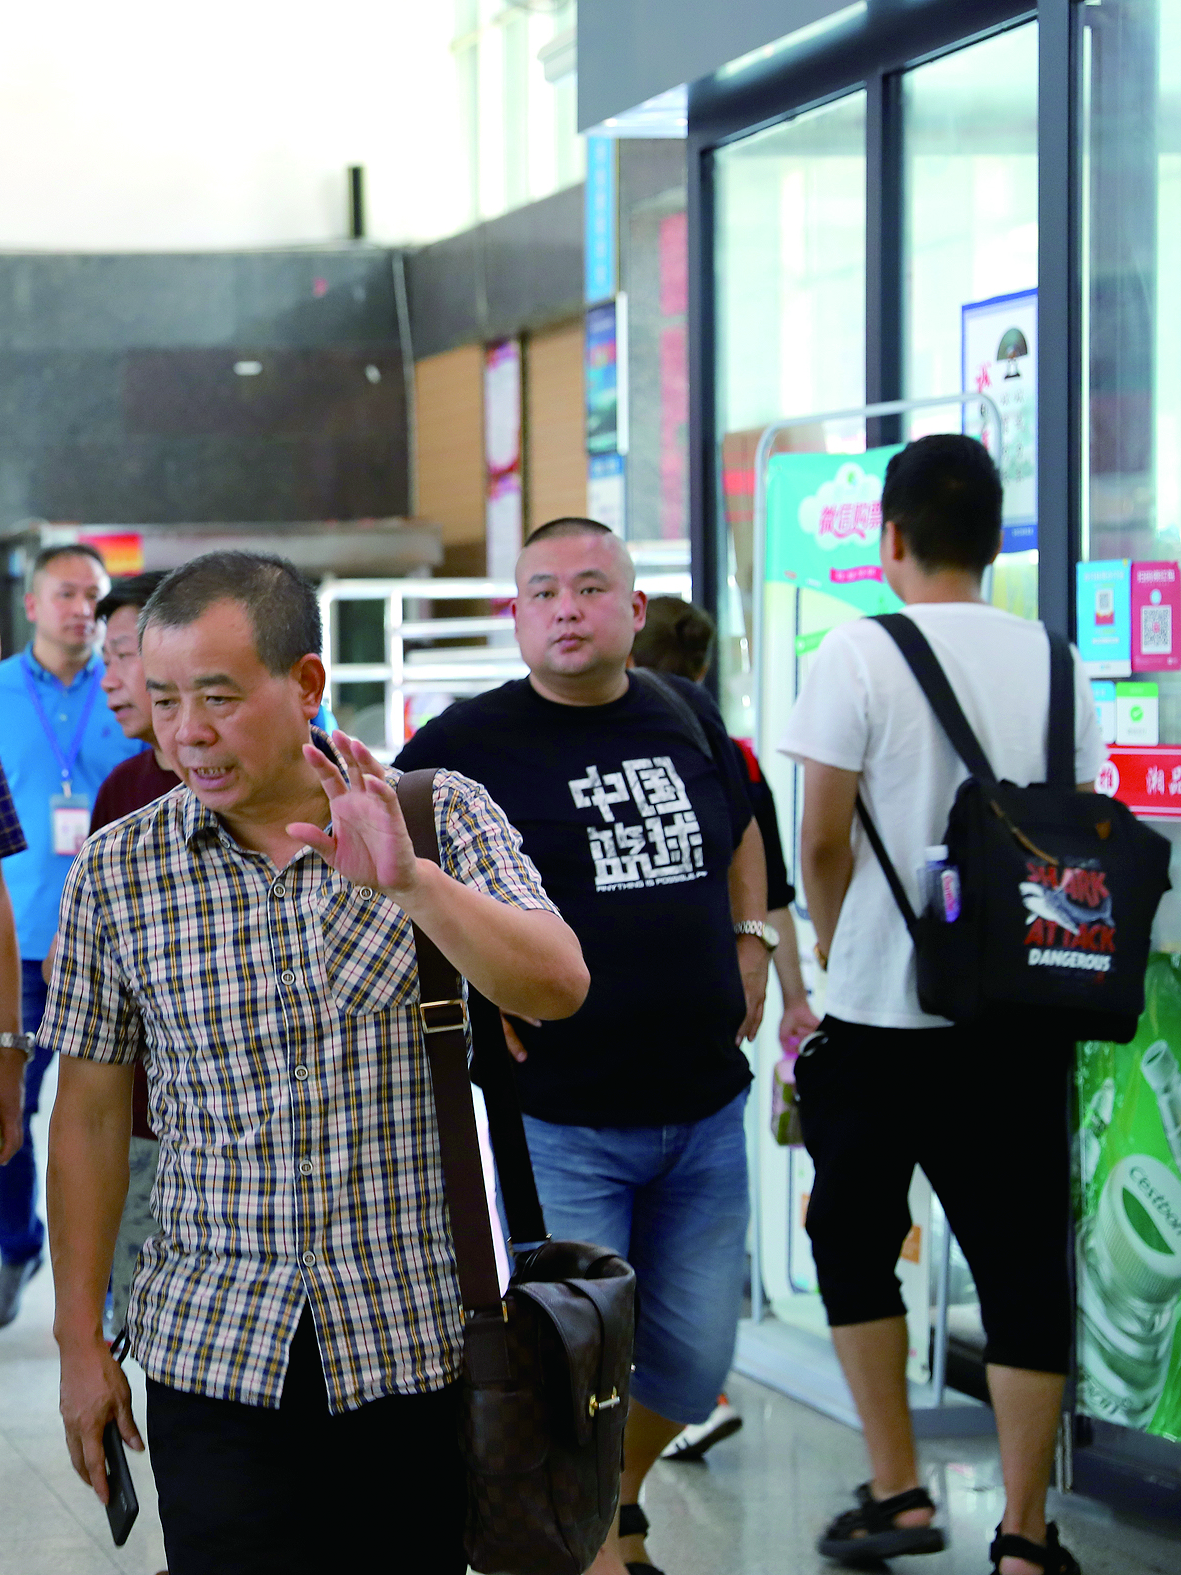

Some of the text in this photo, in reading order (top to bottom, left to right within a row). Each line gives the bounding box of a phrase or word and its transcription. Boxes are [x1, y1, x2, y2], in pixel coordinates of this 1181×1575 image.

[568, 756, 692, 822] 中国
[587, 811, 704, 886] 篮球
[1024, 918, 1116, 953] ATTACK
[1028, 948, 1112, 972] DANGEROUS
